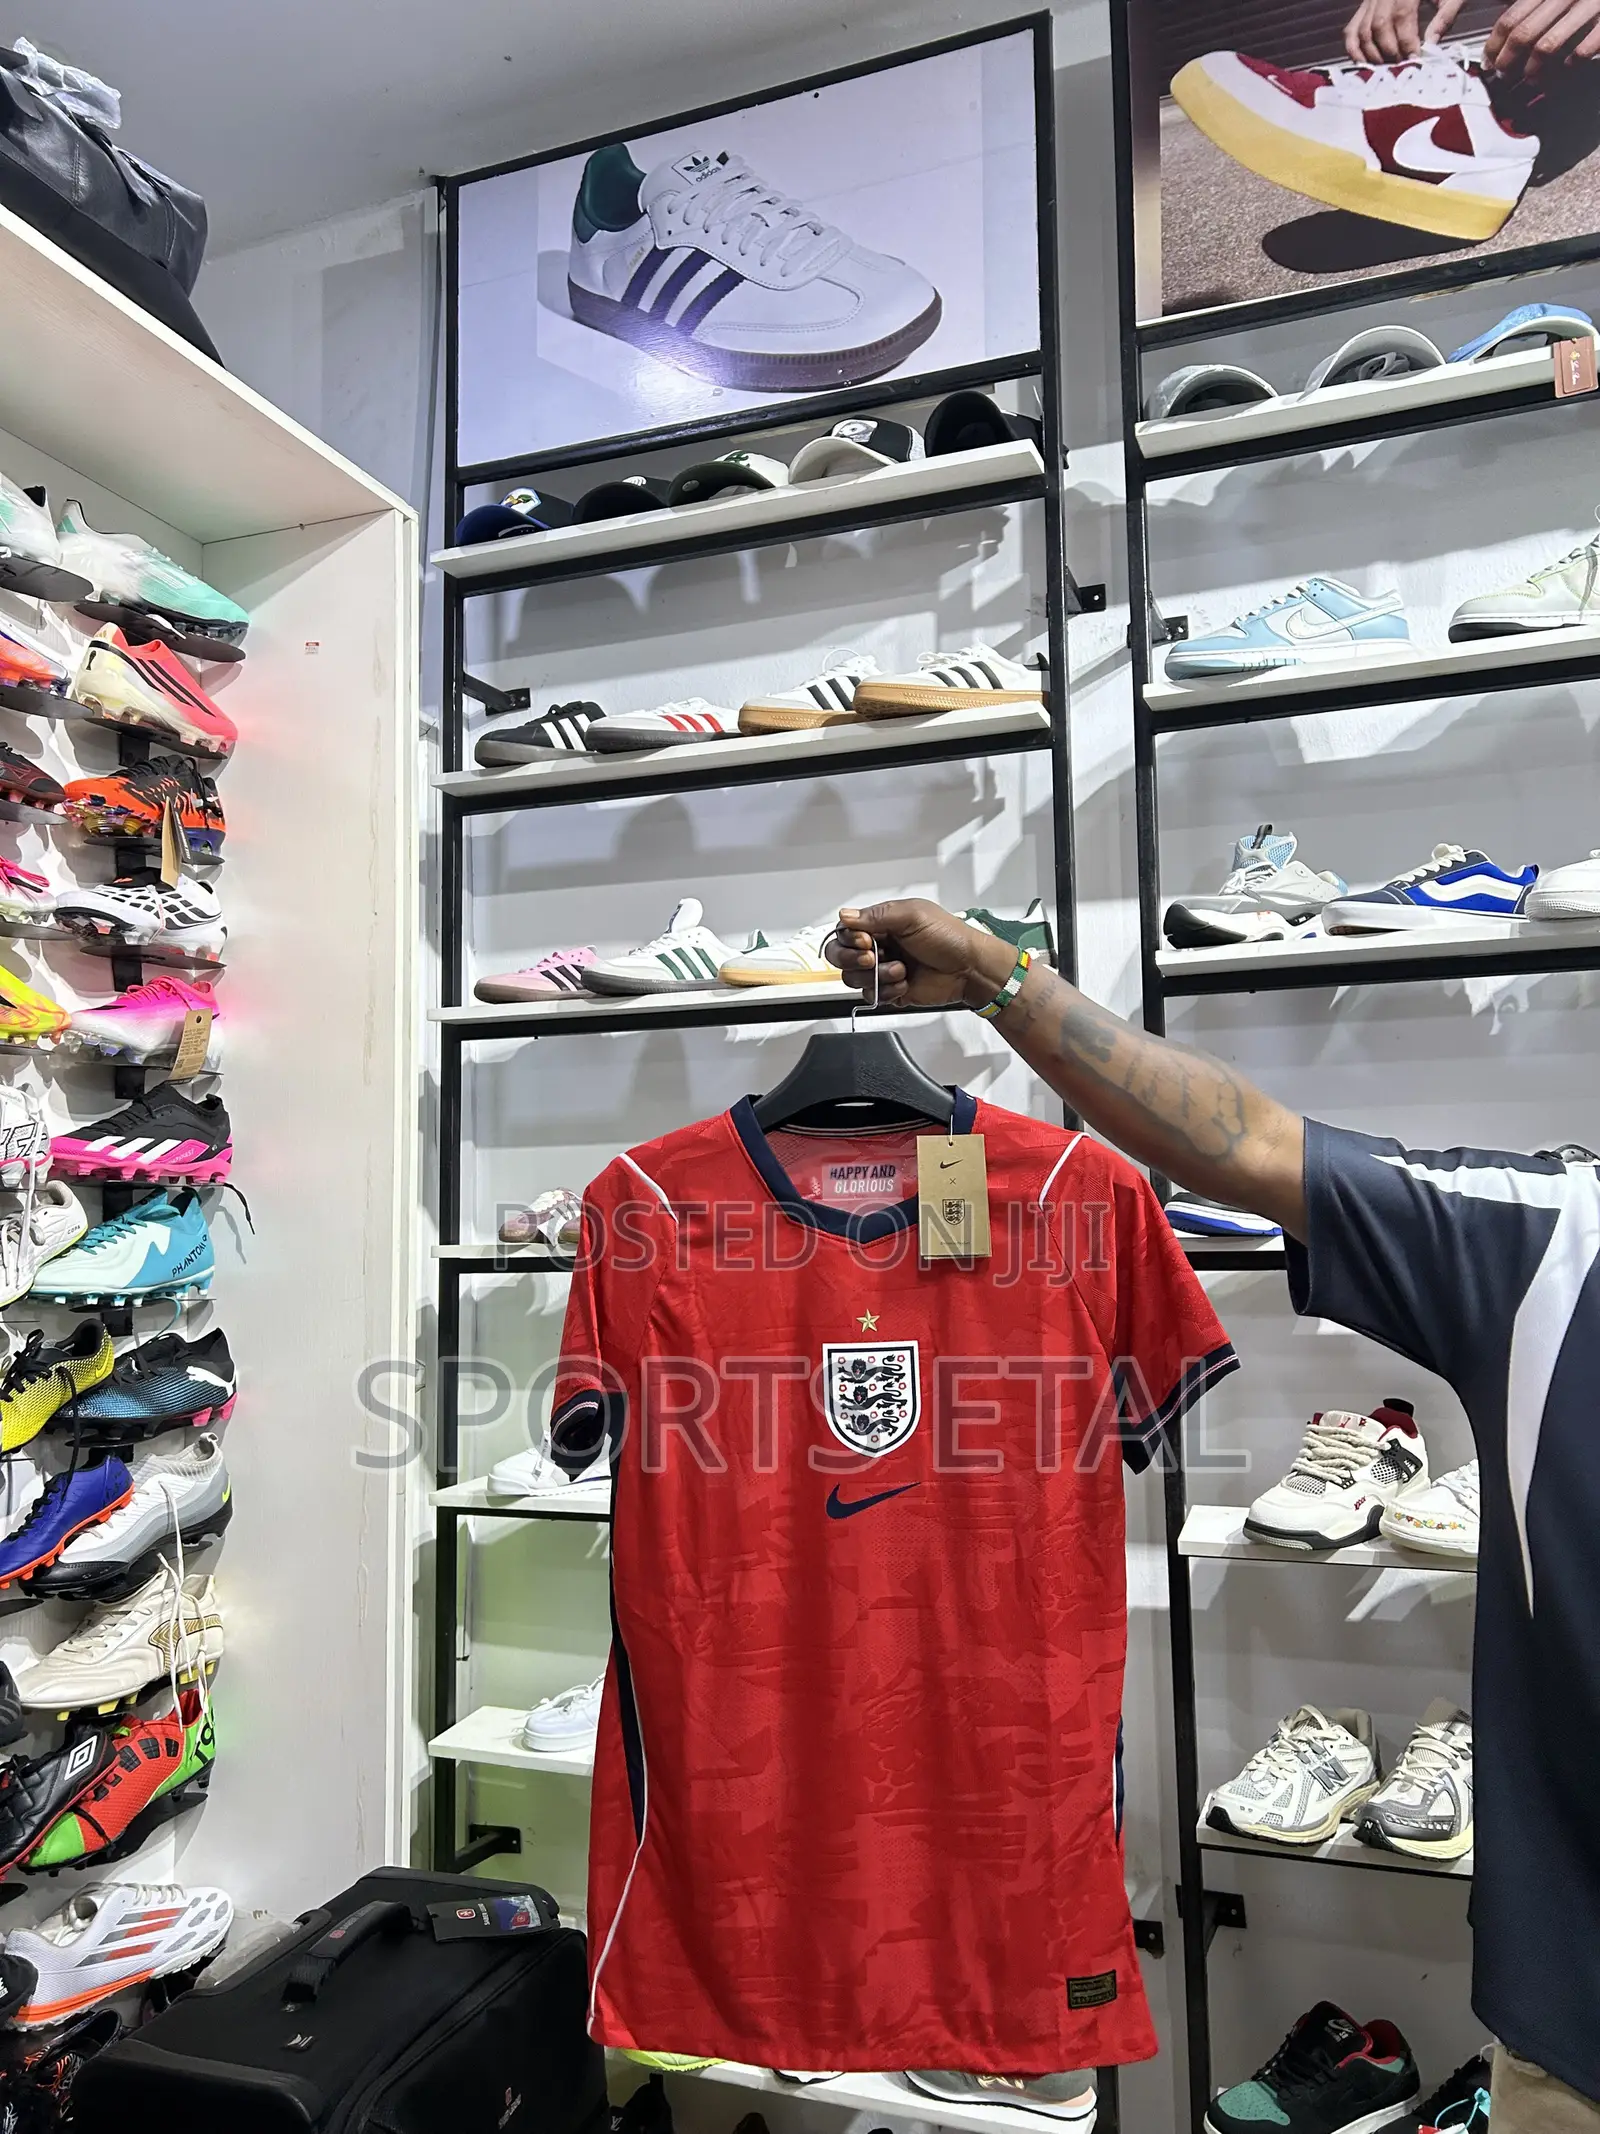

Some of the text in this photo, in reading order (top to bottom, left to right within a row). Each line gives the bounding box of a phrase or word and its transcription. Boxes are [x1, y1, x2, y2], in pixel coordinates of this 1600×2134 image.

[830, 1164, 897, 1180] HAPPY AND
[834, 1179, 894, 1194] GLORIOUS
